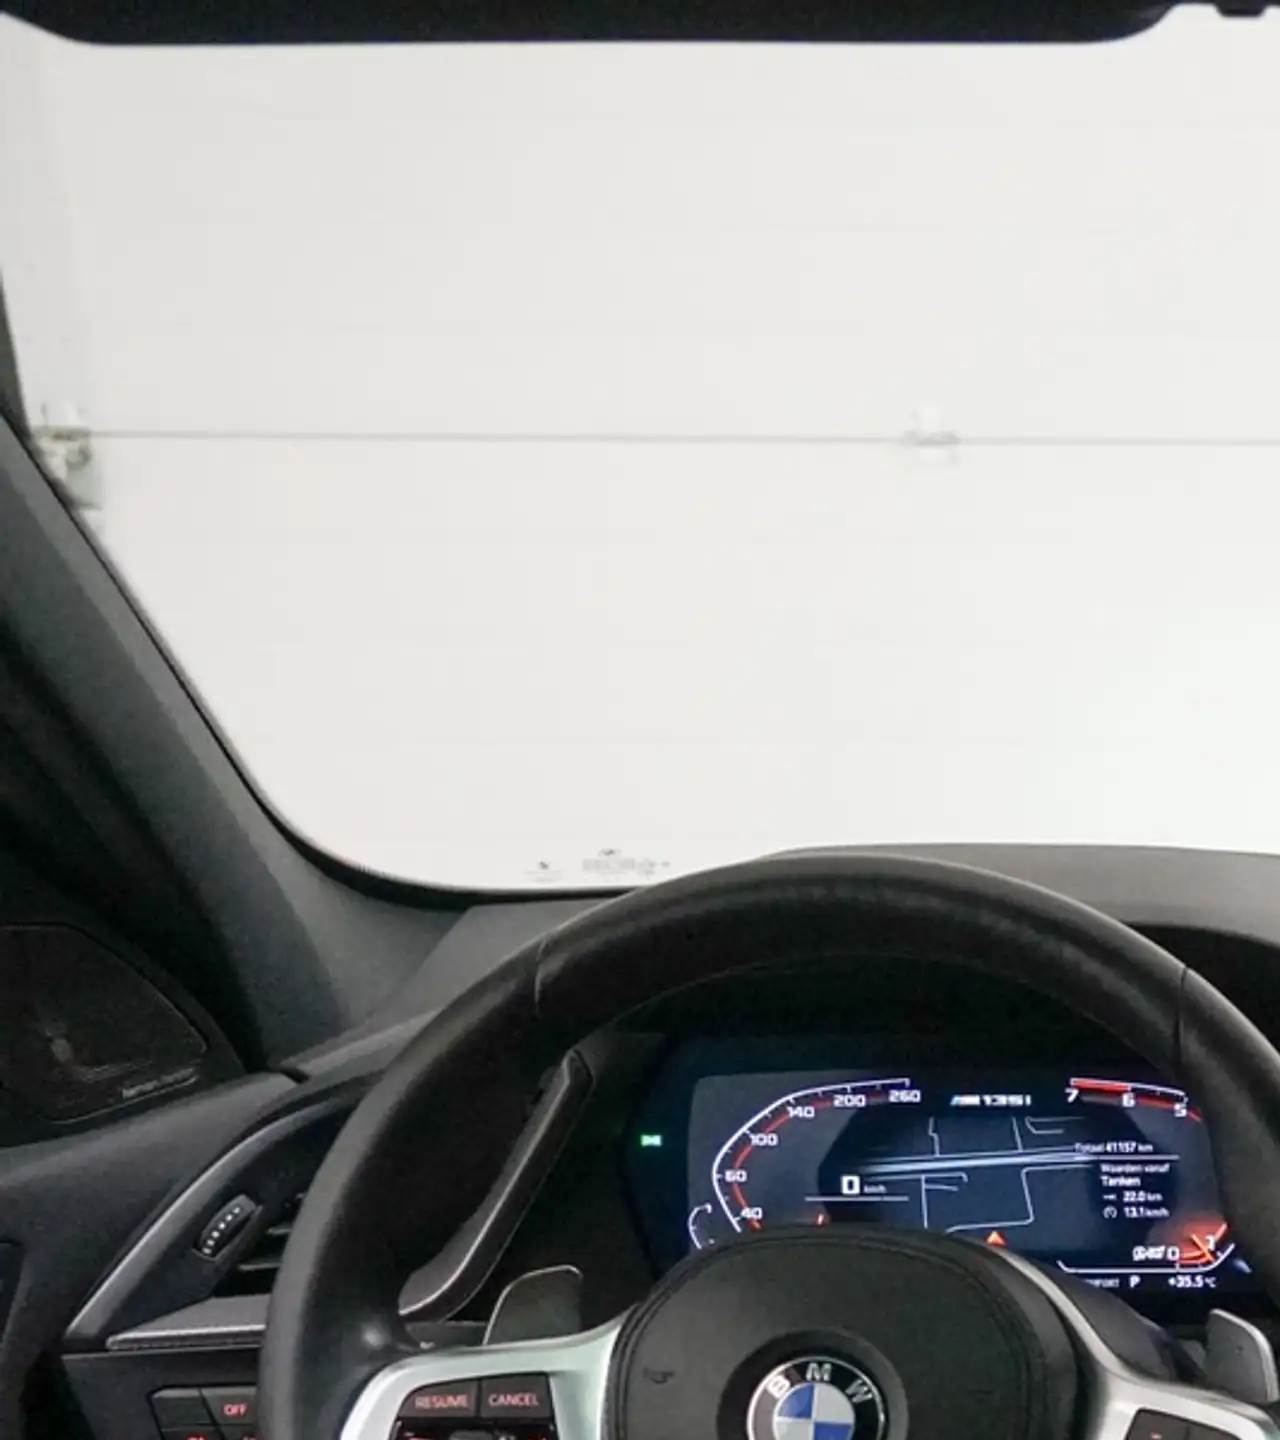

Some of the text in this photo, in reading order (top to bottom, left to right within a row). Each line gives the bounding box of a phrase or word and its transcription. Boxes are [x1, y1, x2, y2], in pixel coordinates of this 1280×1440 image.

[833, 1095, 866, 1107] 200
[889, 1090, 921, 1103] 260
[1065, 1088, 1080, 1103] 7
[1122, 1093, 1136, 1107] 6
[787, 1106, 815, 1118] 140
[1174, 1104, 1187, 1117] 5
[750, 1133, 777, 1146] 100
[725, 1169, 747, 1182] 60
[1101, 1175, 1141, 1187] Tanken
[841, 1175, 860, 1195] 0
[741, 1207, 763, 1220] 40
[1130, 1275, 1141, 1288] P
[766, 1362, 873, 1404] BMW
[415, 1394, 469, 1409] RESUME
[488, 1393, 540, 1408] CANCEL
